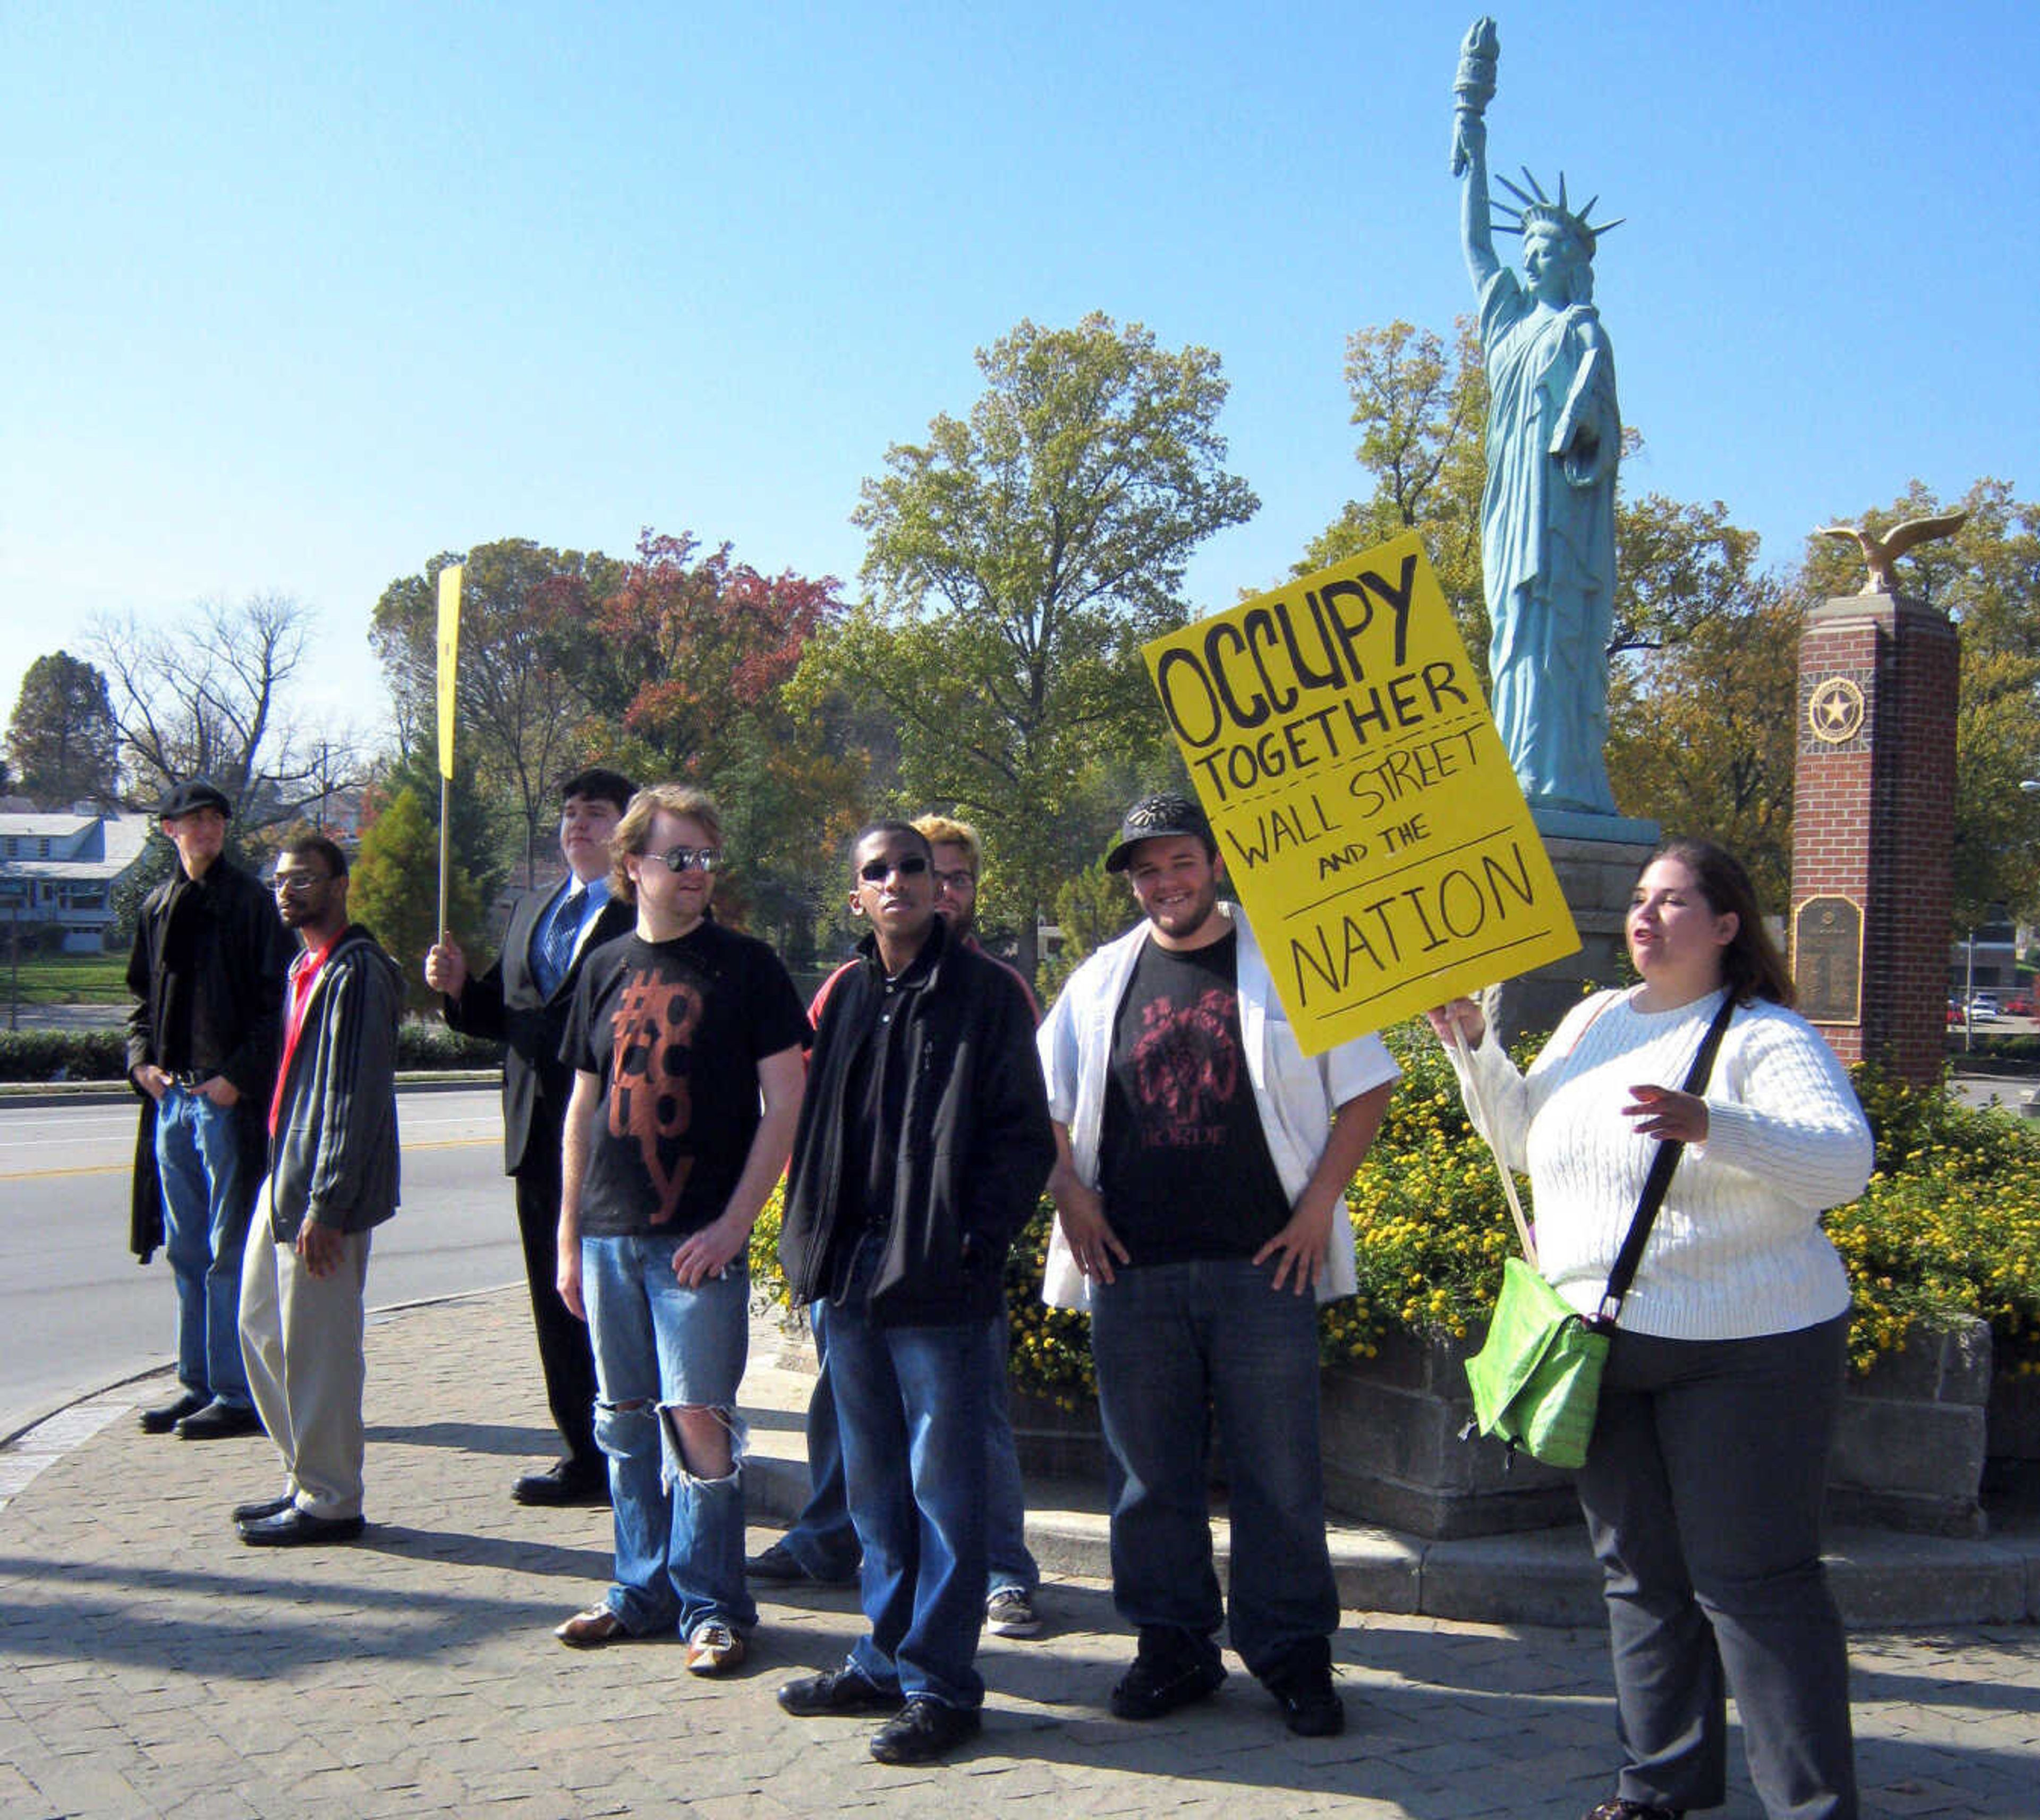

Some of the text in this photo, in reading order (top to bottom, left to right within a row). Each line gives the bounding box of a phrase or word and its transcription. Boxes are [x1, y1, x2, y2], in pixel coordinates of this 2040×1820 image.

[1158, 554, 1417, 748] OCCUPY
[1194, 662, 1468, 801] TOGETHER
[1226, 722, 1485, 869] WALL STREET
[1319, 813, 1432, 880] AND THE
[1290, 842, 1534, 1008] NATION
